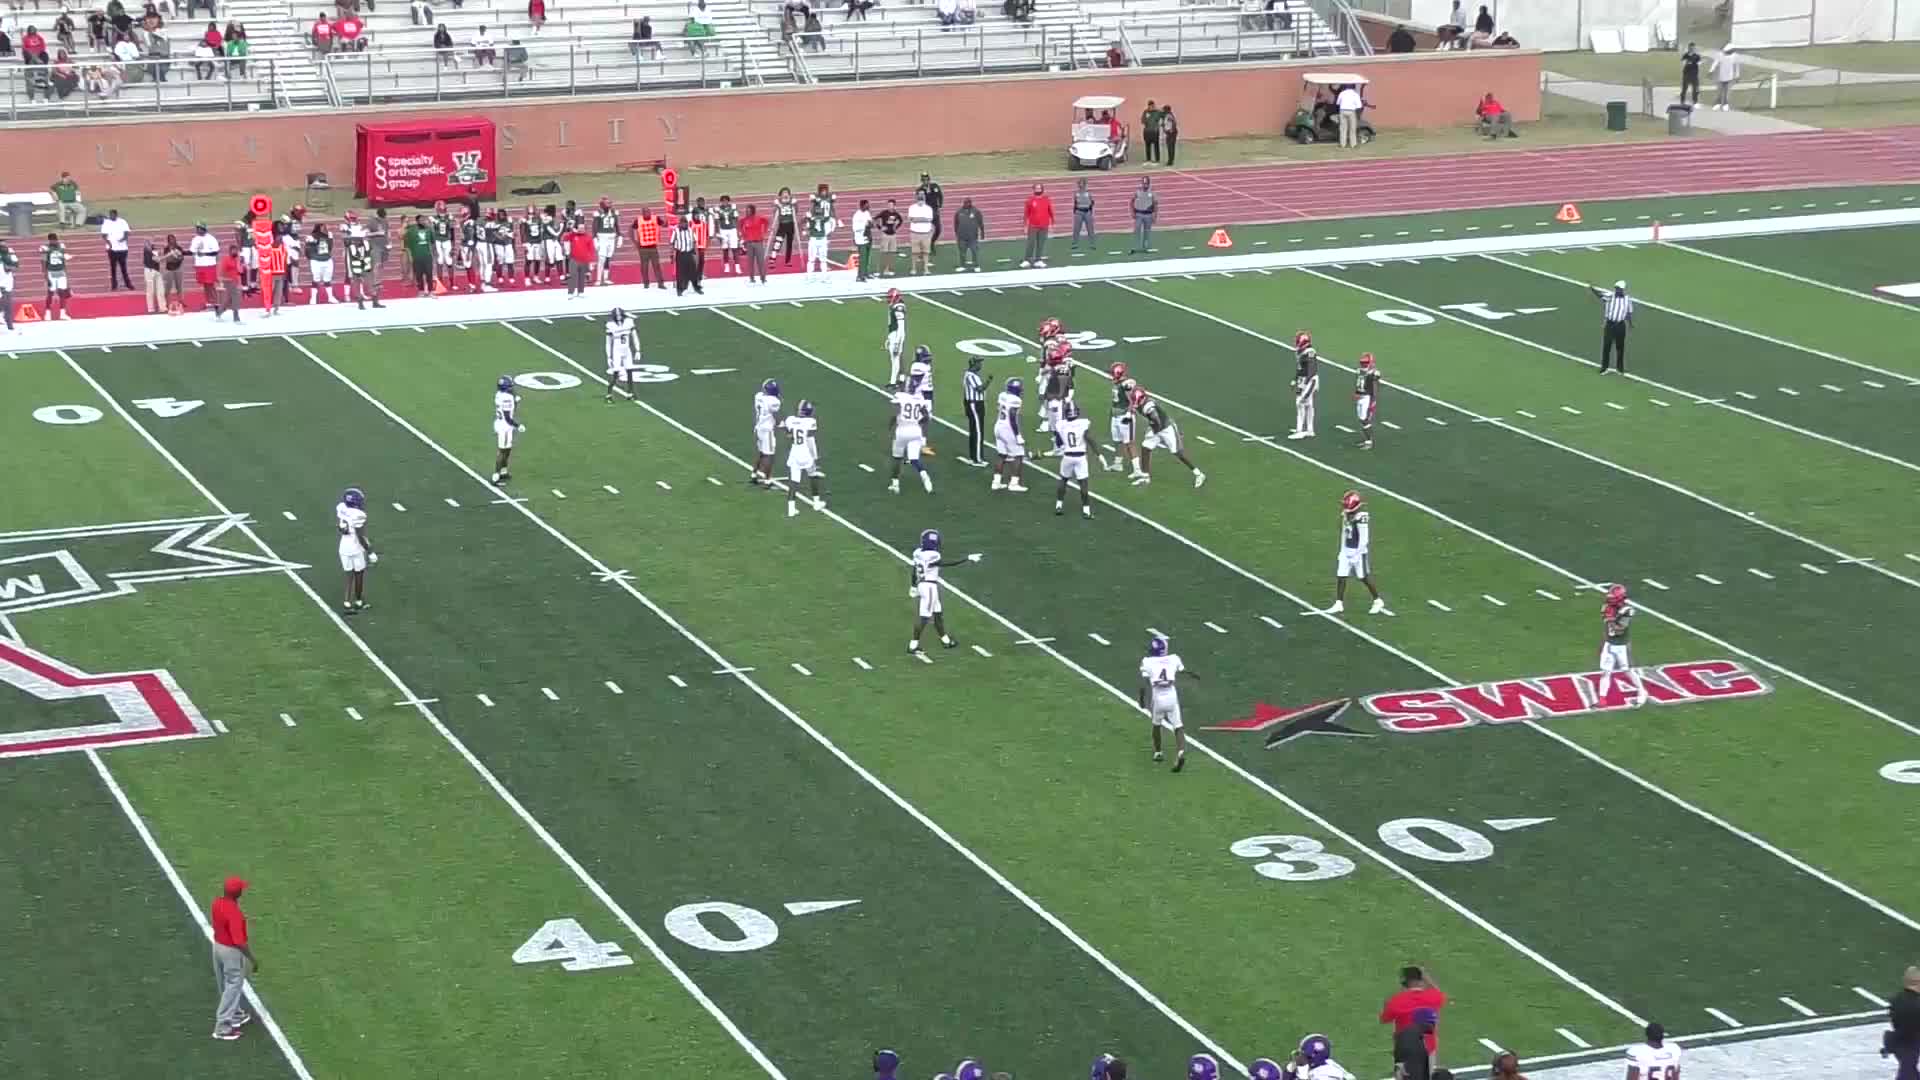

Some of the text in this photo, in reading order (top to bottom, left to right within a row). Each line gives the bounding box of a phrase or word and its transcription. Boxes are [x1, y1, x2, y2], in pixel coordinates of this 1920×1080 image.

[388, 154, 434, 168] specialty
[388, 164, 445, 178] orthopedic
[388, 179, 420, 190] group
[903, 403, 922, 420] 90
[1363, 660, 1772, 732] SWAC
[1230, 818, 1494, 881] 30
[512, 902, 779, 971] 40
